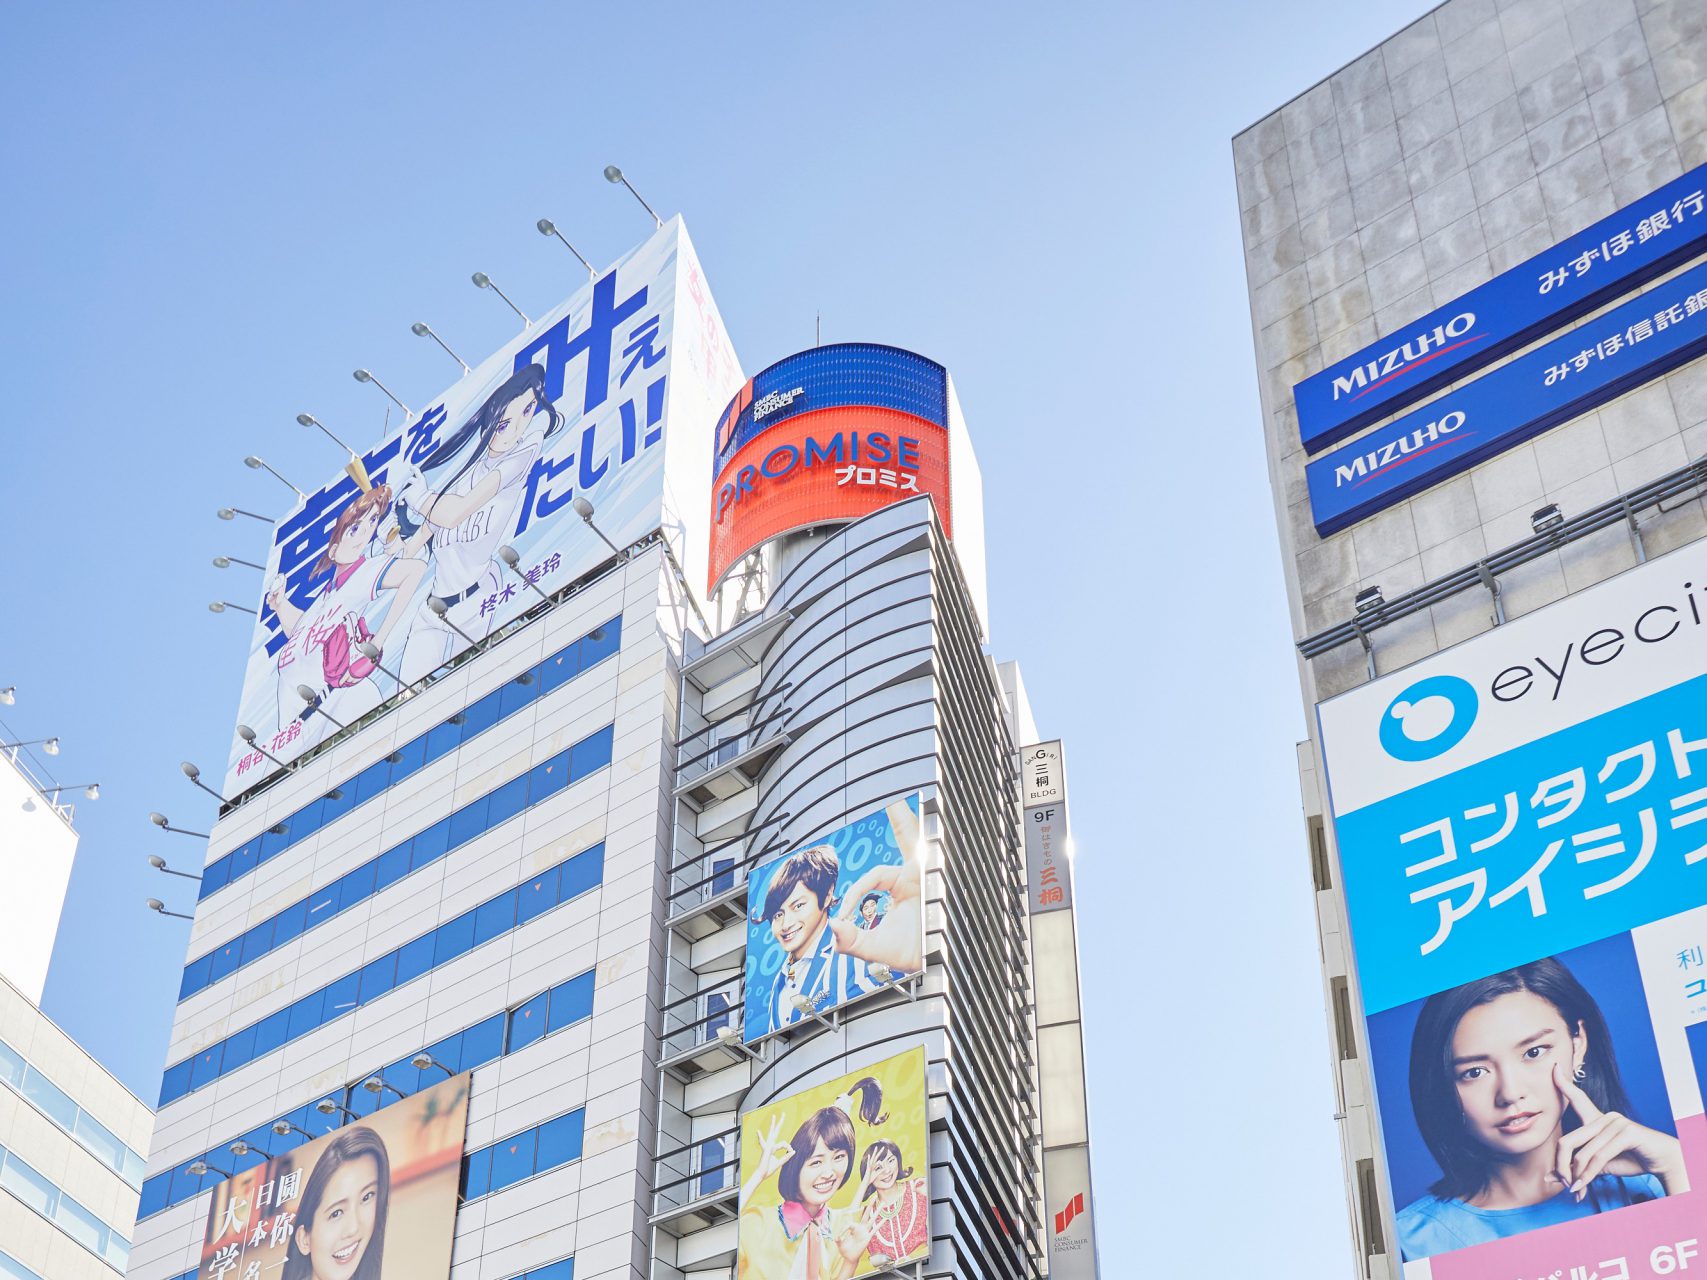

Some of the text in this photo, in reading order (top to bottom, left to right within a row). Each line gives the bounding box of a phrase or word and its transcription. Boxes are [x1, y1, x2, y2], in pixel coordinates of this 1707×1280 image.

[1538, 190, 1706, 295] みずほ銀行
[1333, 312, 1476, 401] MIZUHO
[754, 390, 778, 408] SMBC
[754, 387, 804, 414] CONSUMER
[754, 397, 794, 422] FINANCE
[1334, 411, 1466, 488] MIZUHO
[716, 432, 920, 523] PROMISE
[835, 464, 919, 493] プロミス
[1491, 581, 1707, 702] eyeci
[1030, 789, 1056, 799] BLDG
[1399, 728, 1707, 877] コンタクト
[1034, 810, 1054, 823] 9F
[1038, 867, 1063, 905] 三桐
[1054, 1238, 1088, 1248] CONSUMER
[1055, 1243, 1081, 1253] FINANCE
[1649, 1239, 1699, 1276] 6F
